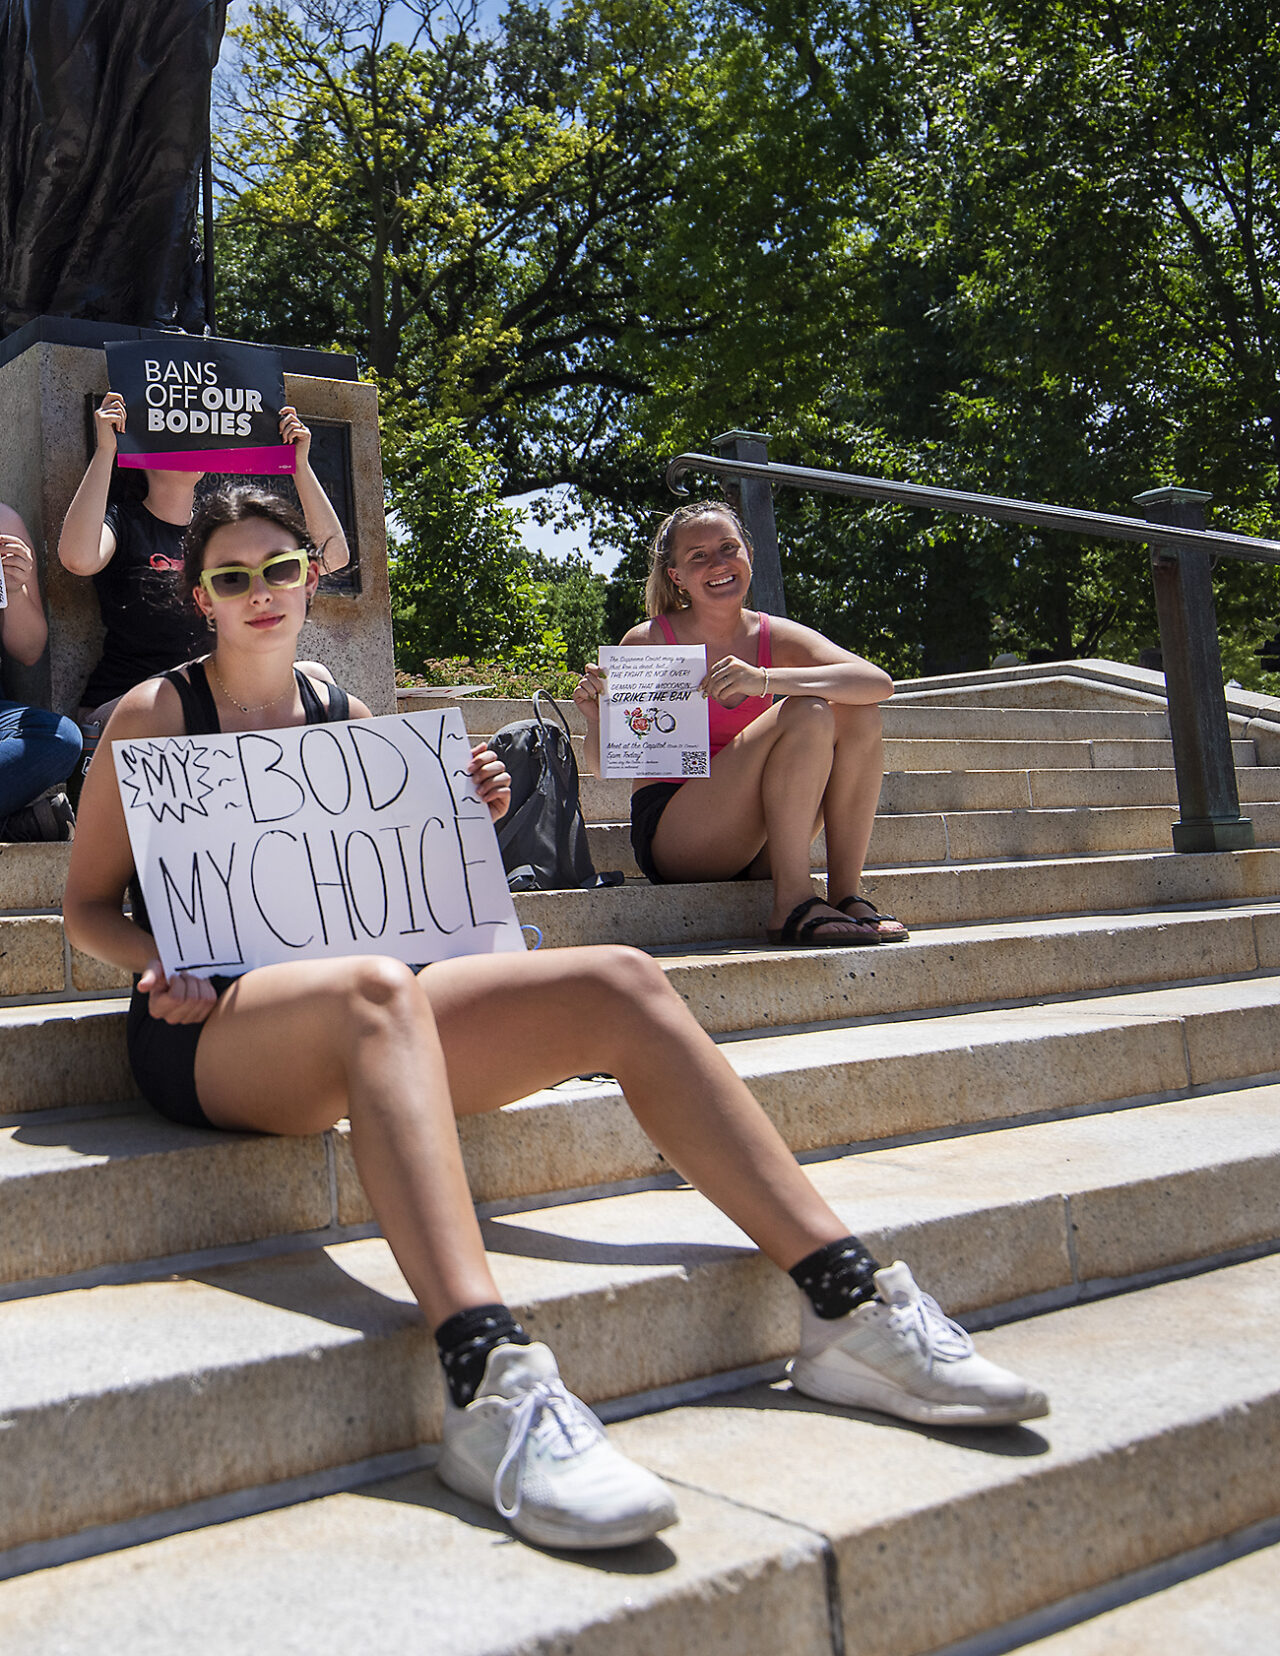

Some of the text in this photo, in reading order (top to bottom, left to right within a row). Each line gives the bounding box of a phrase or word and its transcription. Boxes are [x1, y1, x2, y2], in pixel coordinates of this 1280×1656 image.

[145, 360, 218, 386] BANS
[146, 383, 264, 412] OFF OUR
[148, 408, 252, 436] BODIES
[611, 691, 691, 702] STRIKE THE BAN
[643, 742, 666, 750] Capitol
[141, 714, 458, 823] MY BODY
[158, 816, 508, 964] MY CHOICE
